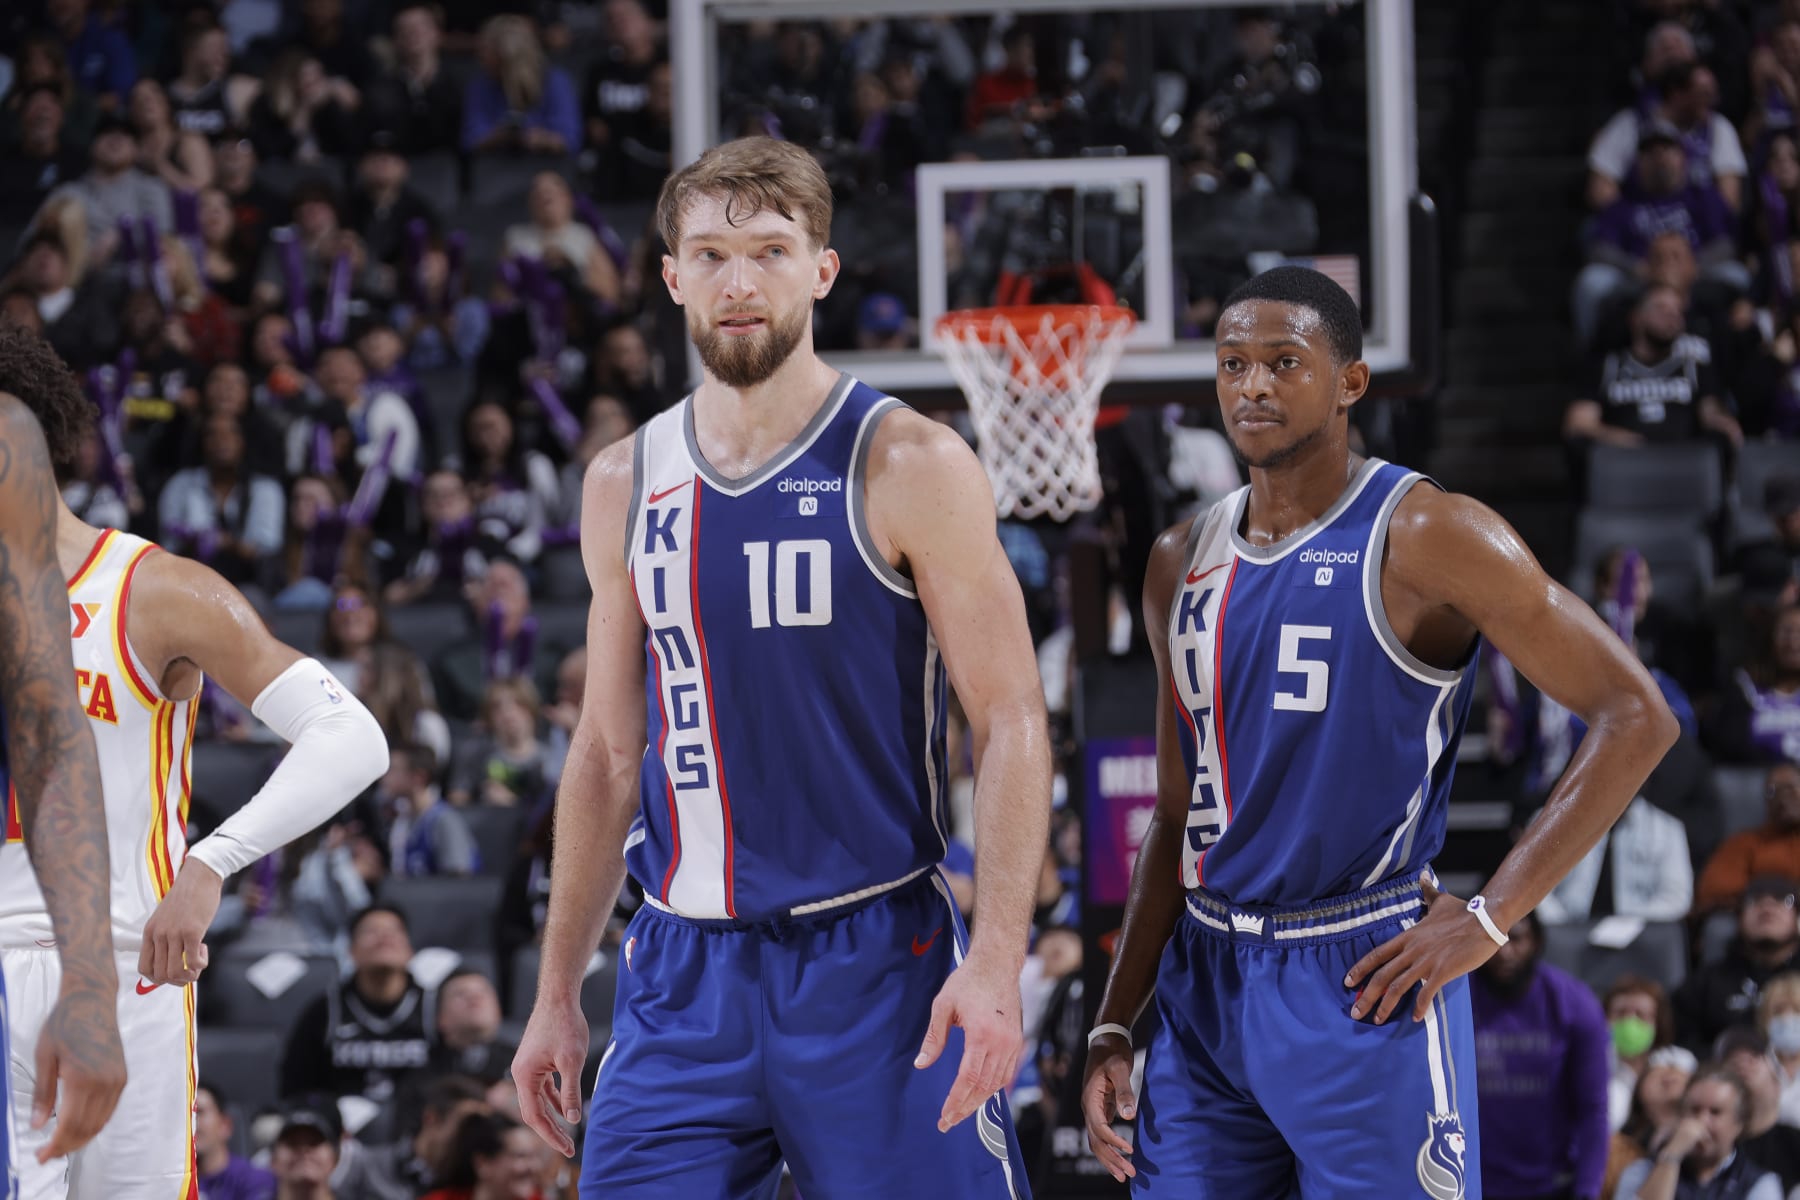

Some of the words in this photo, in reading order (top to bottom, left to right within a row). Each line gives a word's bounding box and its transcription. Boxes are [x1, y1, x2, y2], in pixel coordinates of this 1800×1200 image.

[777, 477, 842, 495] dialpad
[743, 539, 832, 628] 10
[1299, 548, 1360, 566] dialpad
[1273, 624, 1332, 712] 5
